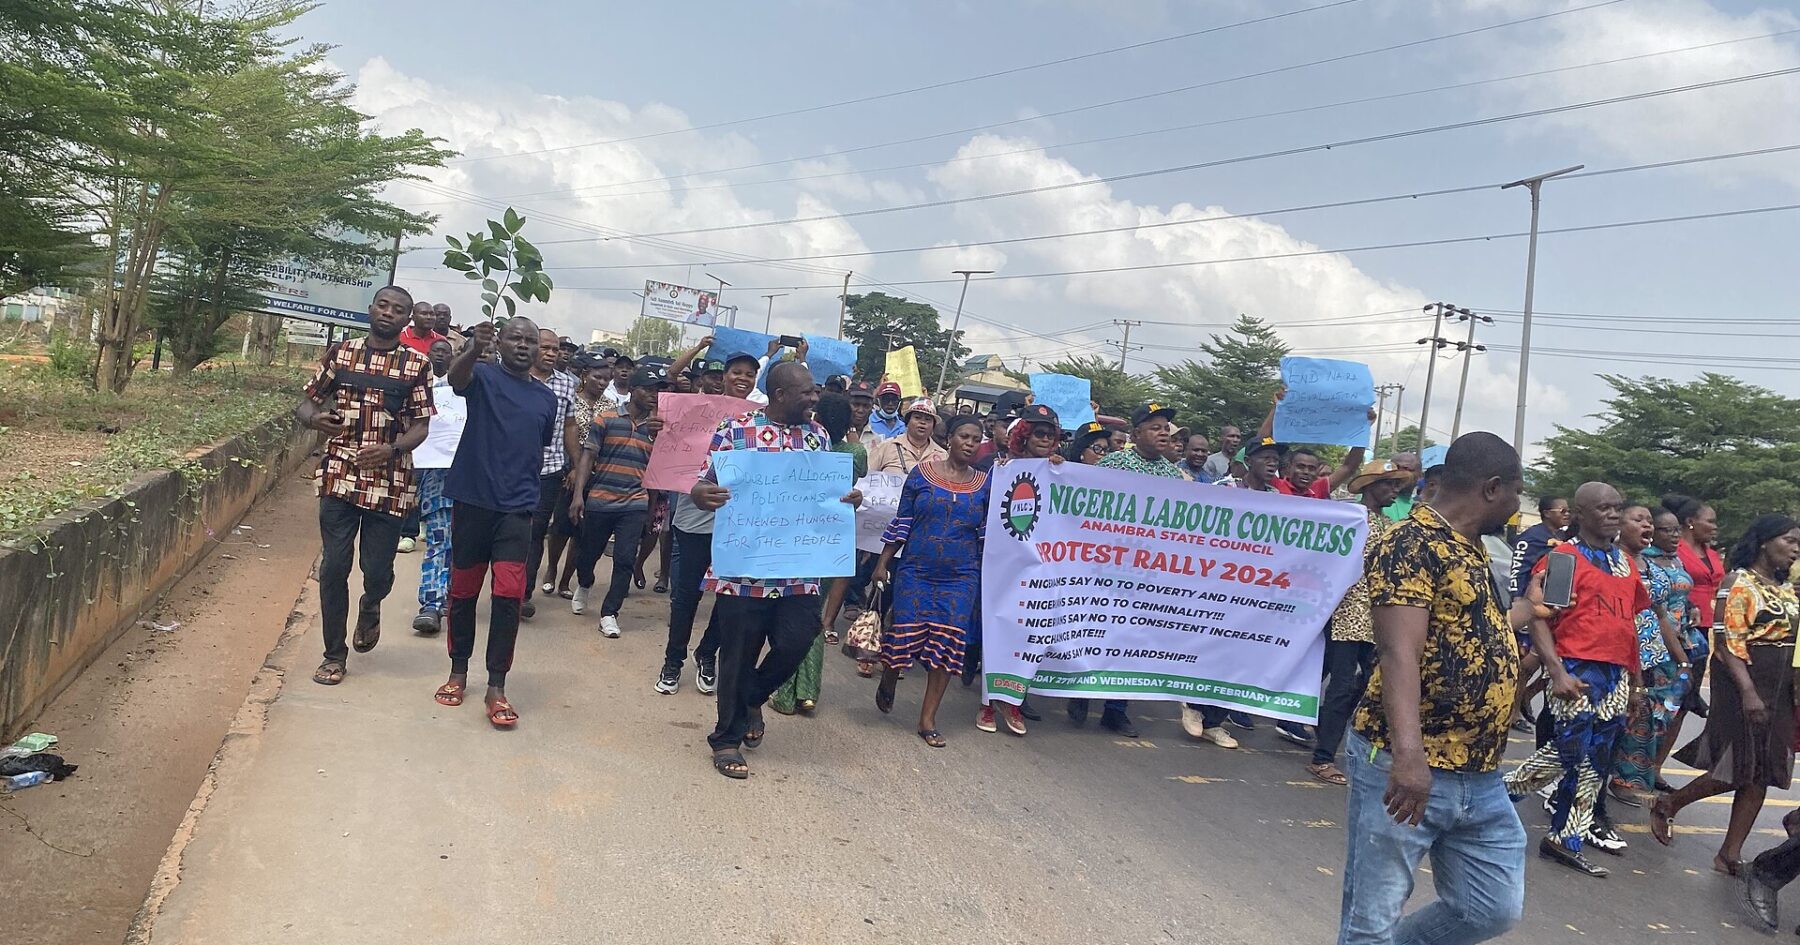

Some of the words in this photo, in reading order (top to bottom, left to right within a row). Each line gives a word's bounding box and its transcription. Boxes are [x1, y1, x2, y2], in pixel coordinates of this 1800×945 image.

[311, 271, 373, 288] PARTNERSHIP
[273, 300, 315, 312] WELFARE
[318, 307, 336, 316] FOR
[340, 311, 355, 319] ALL
[1288, 366, 1319, 384] END
[726, 464, 780, 486] DOUBLE
[788, 468, 850, 481] ALLOCATION
[870, 474, 903, 488] END
[751, 491, 827, 506] POLITICIANS
[727, 505, 789, 527] RENEWED
[795, 513, 844, 526] HUNGER
[1049, 483, 1137, 523] NIGERIA
[1141, 496, 1234, 537] LABOUR
[1237, 511, 1357, 557] CONGRESS
[722, 533, 750, 548] FOR
[754, 536, 785, 548] THE
[794, 533, 841, 547] PEOPLE
[1080, 520, 1156, 539] ANAMBRA
[1160, 530, 1205, 545] STATE
[1209, 538, 1274, 556] COUNCIL
[1036, 541, 1129, 566] PROTEST
[1133, 549, 1216, 578] RALLY
[1219, 562, 1291, 590] 2024
[1068, 576, 1093, 586] SAY
[1093, 577, 1113, 588] NO
[1117, 580, 1133, 589] TO
[1136, 583, 1197, 598] POVERTY
[1197, 591, 1227, 602] AND
[1230, 595, 1296, 613] HUNGER!!!
[1067, 596, 1089, 606] SAY
[1090, 597, 1110, 607] NO
[1113, 599, 1129, 608] TO
[1132, 600, 1225, 620] CRIMINALITY!!!
[1596, 594, 1634, 621] NL
[1068, 613, 1087, 624] SAY
[1088, 614, 1107, 623] NO
[1111, 615, 1127, 625] TO
[1129, 616, 1207, 633] CONSISTENT
[1209, 627, 1273, 644] INCREASE
[1275, 637, 1290, 648] IN
[1071, 629, 1106, 640] RATE!!!
[1072, 647, 1083, 659] SAY
[1084, 647, 1101, 656] NO
[1105, 648, 1121, 657] TO
[1122, 649, 1198, 663] HARDSHIP!!!
[993, 678, 1026, 693] DATE:
[1076, 674, 1097, 685] AND
[1100, 676, 1166, 688] WEDNESDAY
[1167, 680, 1194, 690] 28TH
[1196, 683, 1211, 692] OF
[1213, 686, 1272, 703] FEBRUARY
[1273, 696, 1301, 709] 2024
